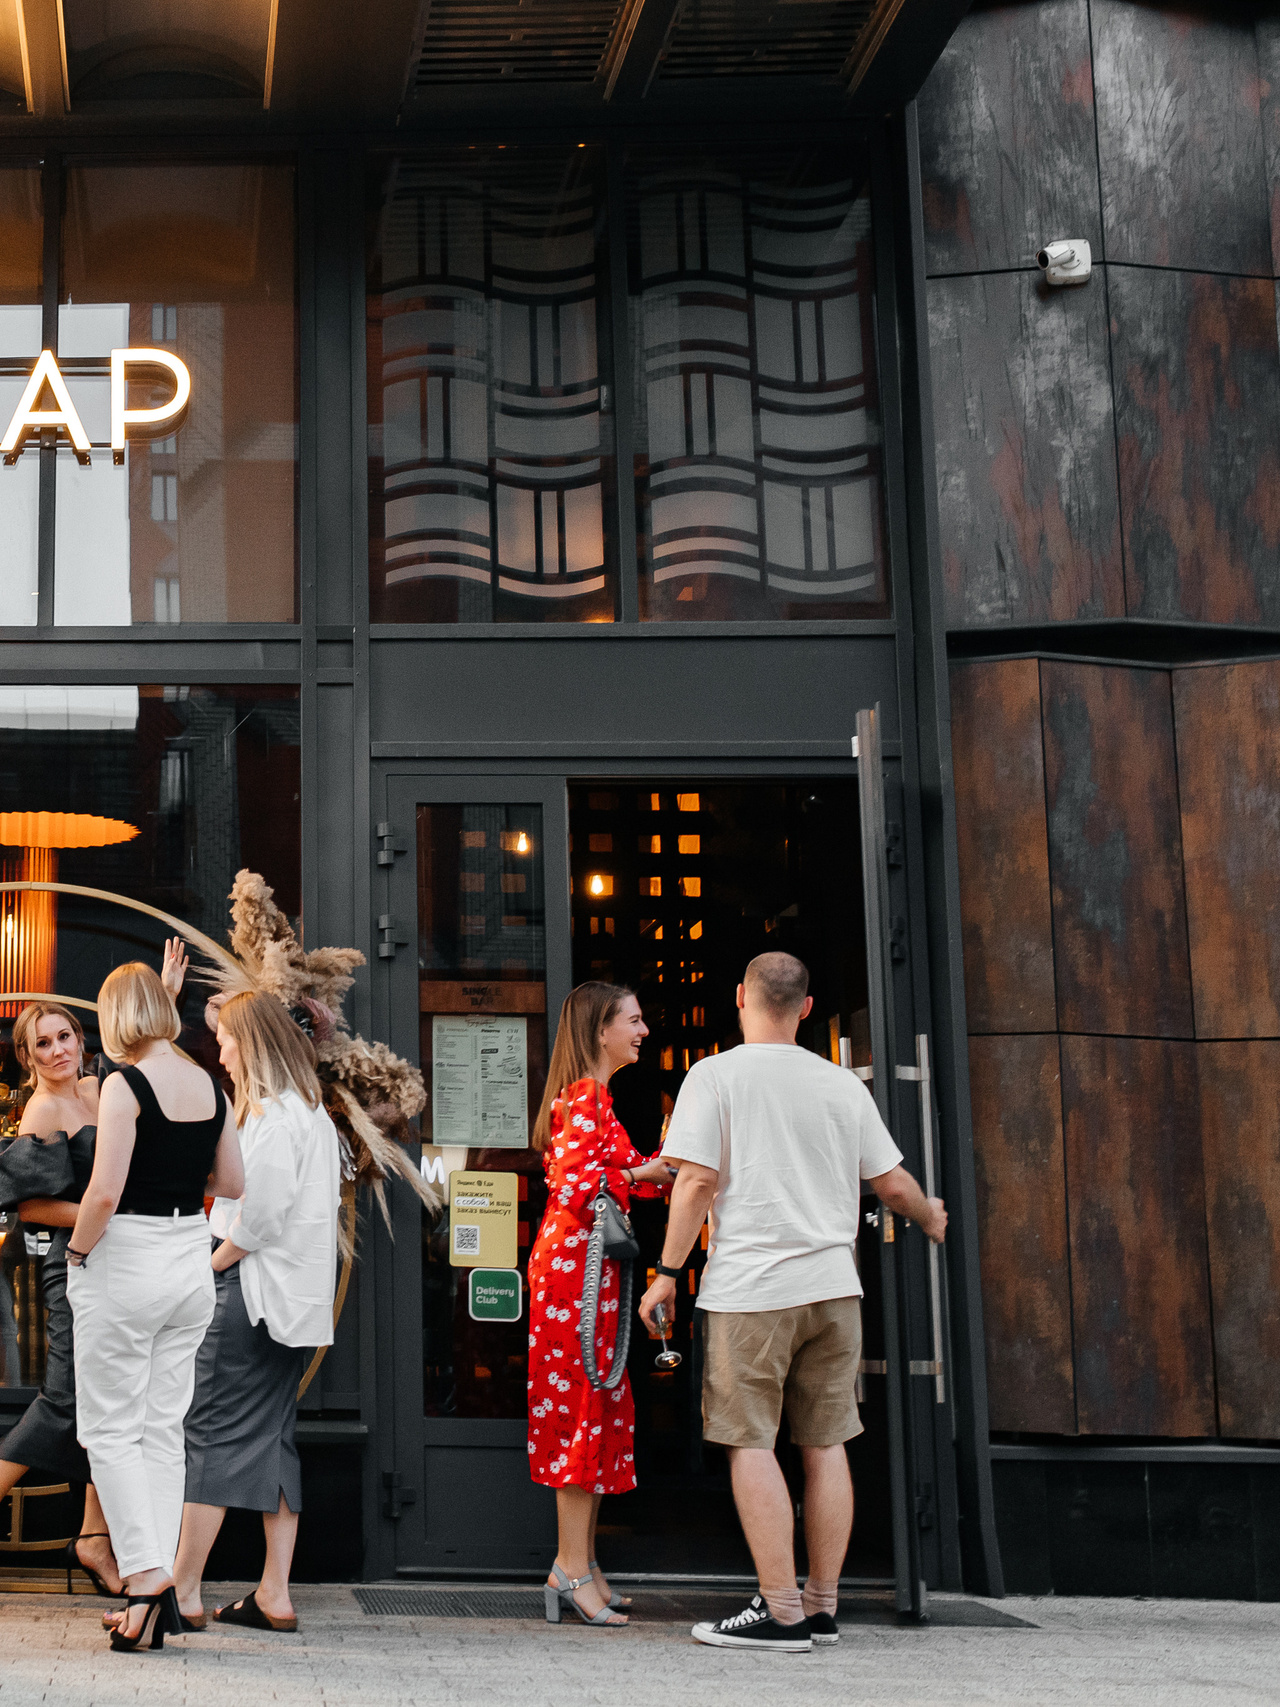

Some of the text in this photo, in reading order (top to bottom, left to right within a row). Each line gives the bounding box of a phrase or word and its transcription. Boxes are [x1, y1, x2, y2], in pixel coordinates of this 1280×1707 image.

[478, 1208, 512, 1216] вынесут
[475, 1286, 515, 1298] Delivery
[475, 1295, 498, 1305] Club
